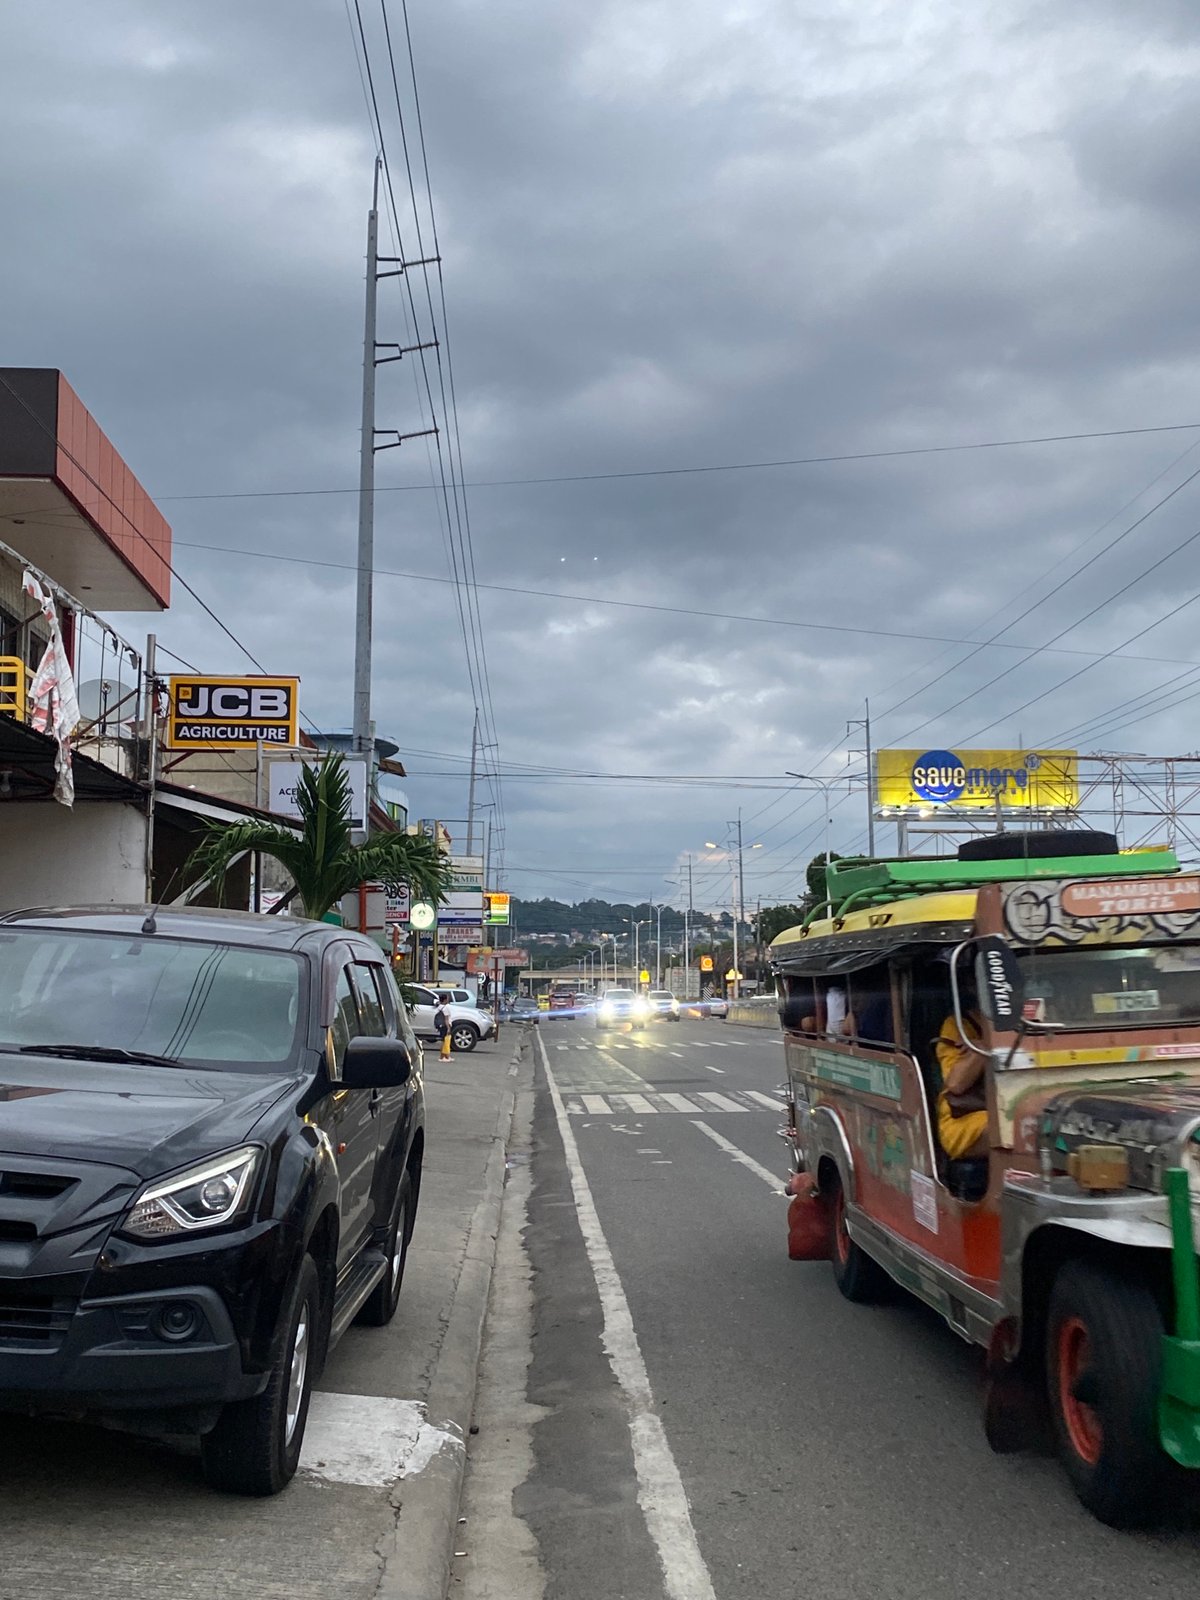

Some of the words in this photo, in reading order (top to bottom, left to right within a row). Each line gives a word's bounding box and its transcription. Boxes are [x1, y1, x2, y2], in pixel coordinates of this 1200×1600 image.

[178, 686, 288, 718] JCB
[178, 725, 287, 741] AGRICULTURE
[985, 950, 1013, 1016] GOODYEAR
